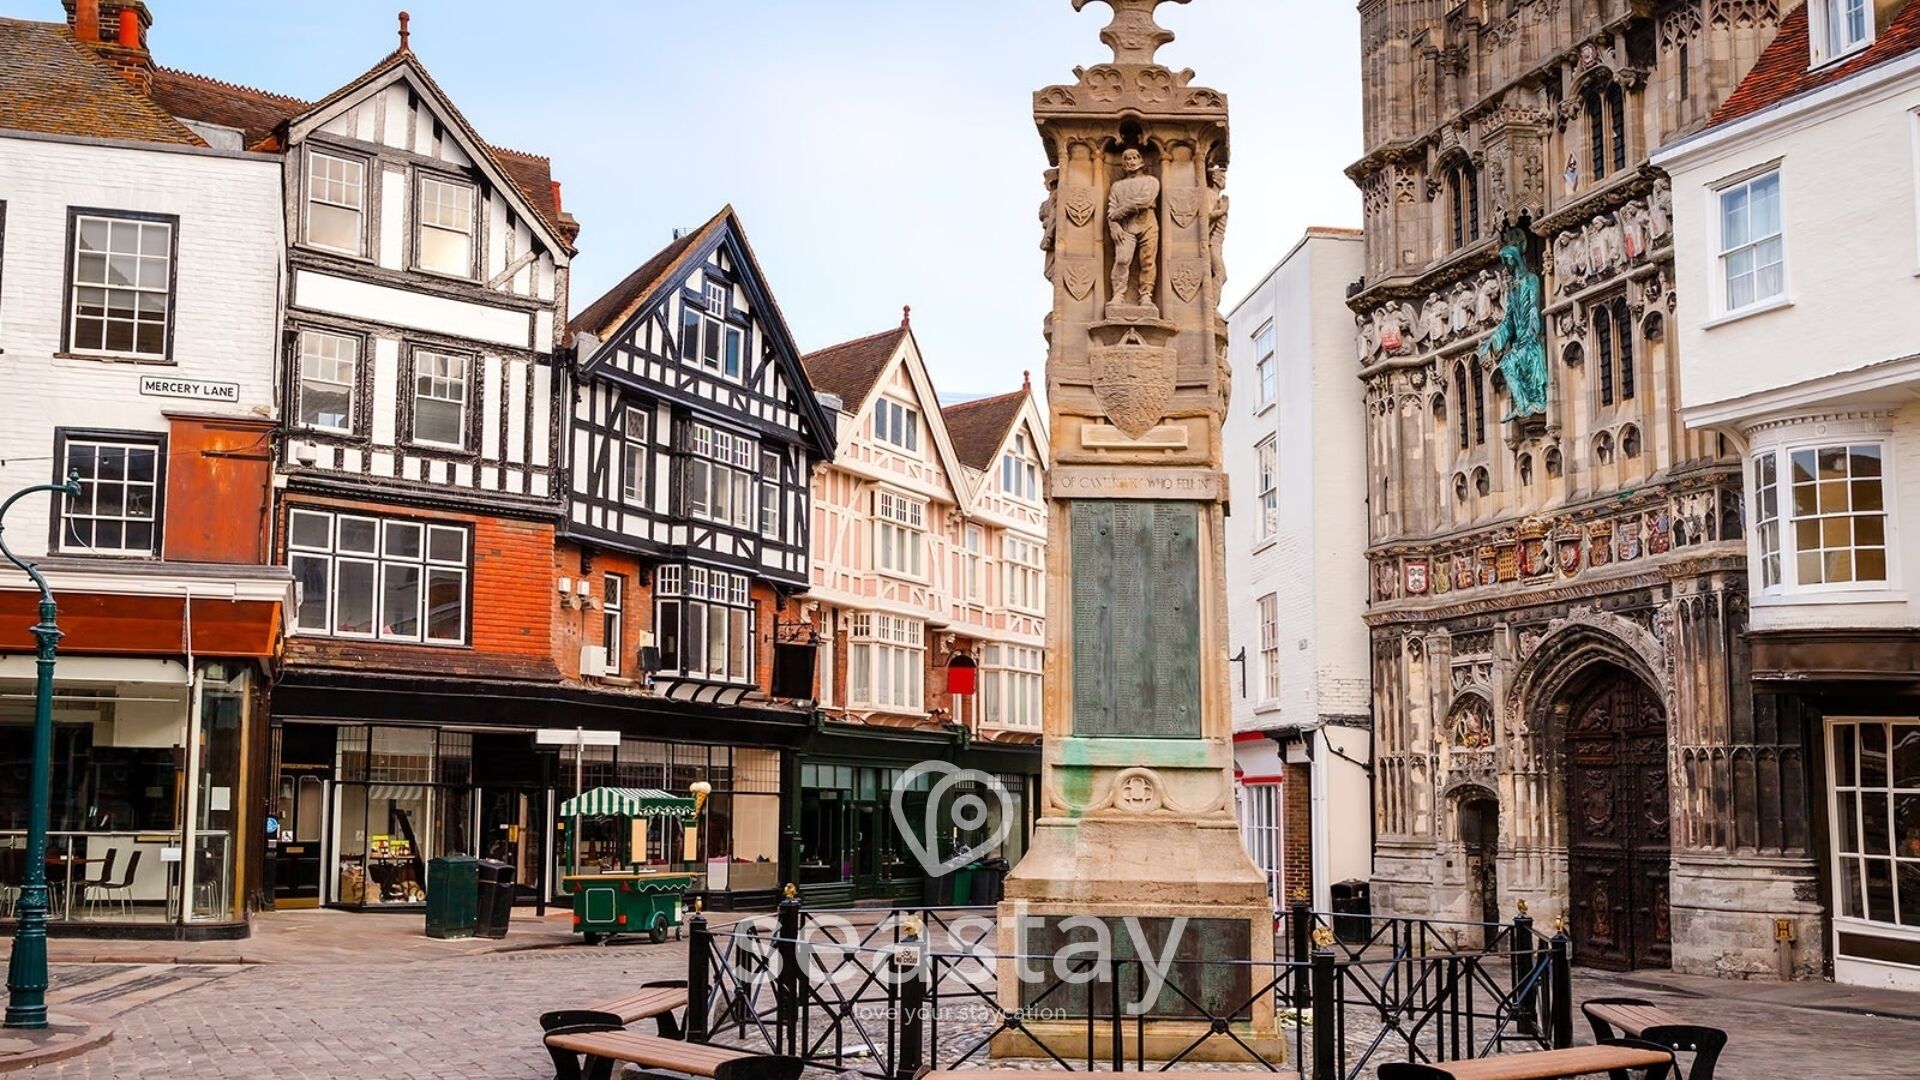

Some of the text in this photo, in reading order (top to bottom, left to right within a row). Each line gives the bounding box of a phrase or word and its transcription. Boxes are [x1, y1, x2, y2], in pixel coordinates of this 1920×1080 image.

[145, 381, 234, 397] MERCERY LANE
[1145, 477, 1173, 489] WHO
